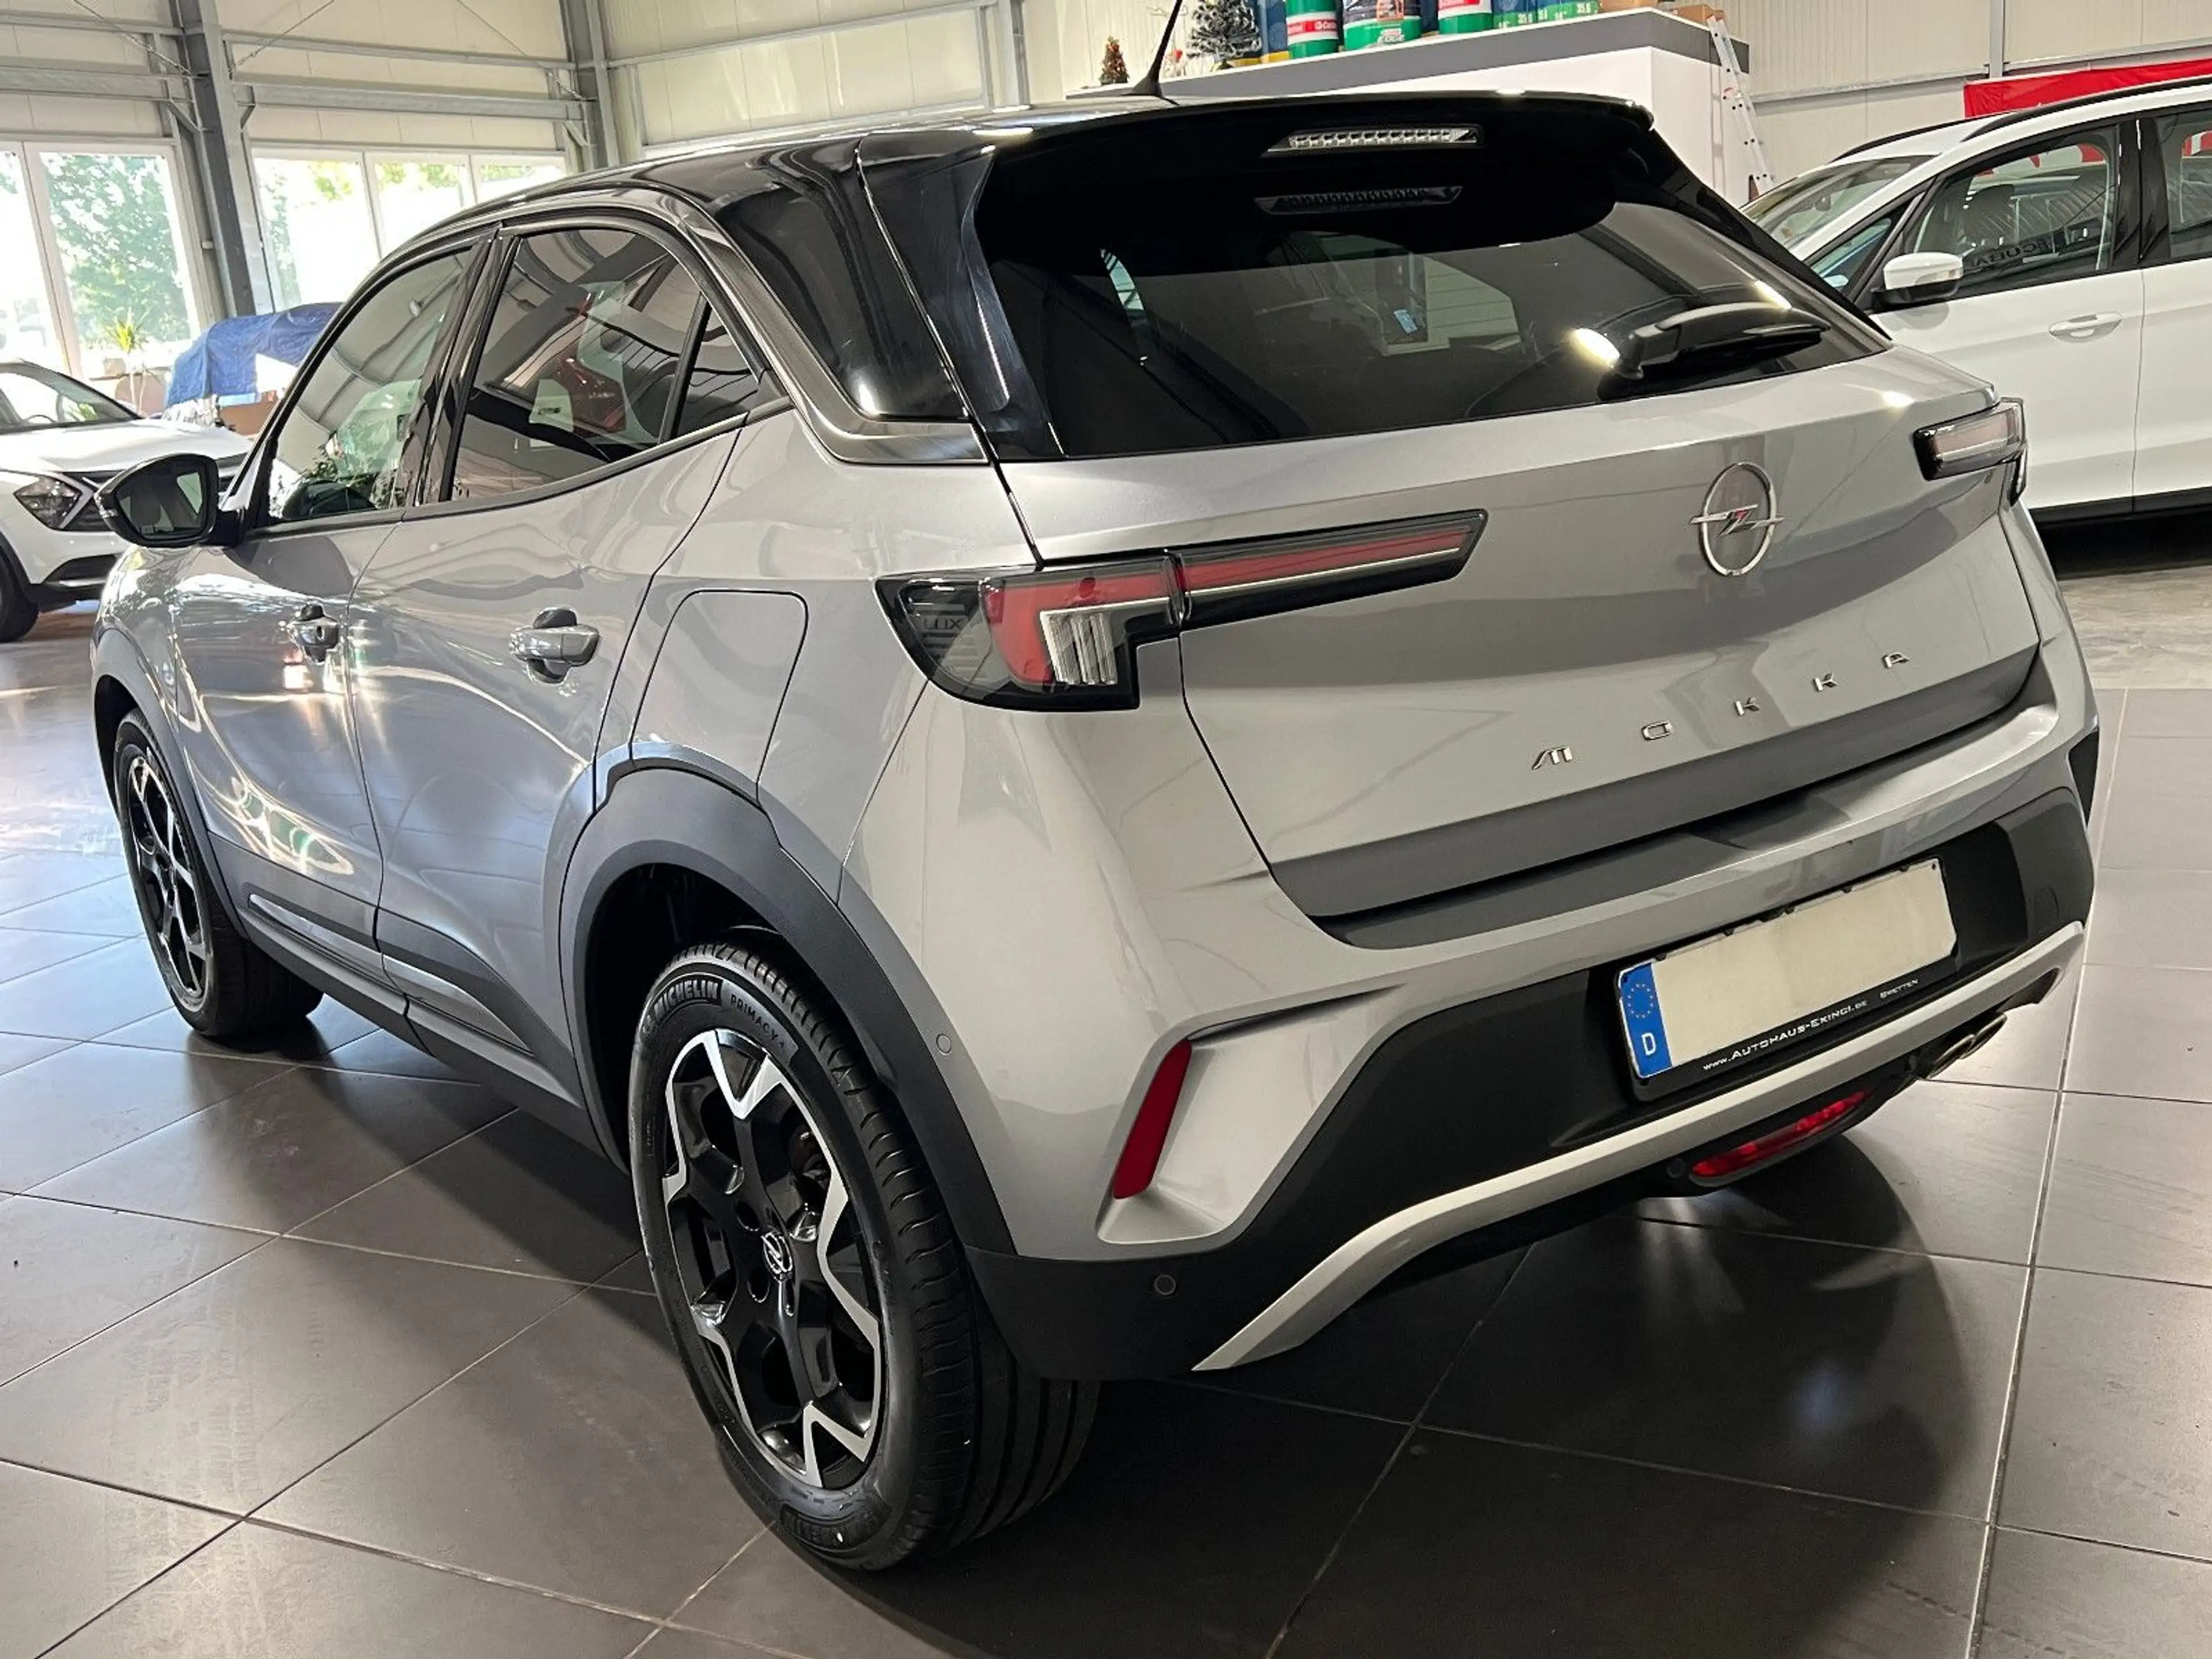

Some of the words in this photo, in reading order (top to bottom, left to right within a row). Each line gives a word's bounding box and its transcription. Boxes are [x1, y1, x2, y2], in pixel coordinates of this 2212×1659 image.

[1532, 652, 1910, 770] MOKKA
[654, 979, 719, 1017] MICHELIN
[1641, 1032, 1657, 1056] D
